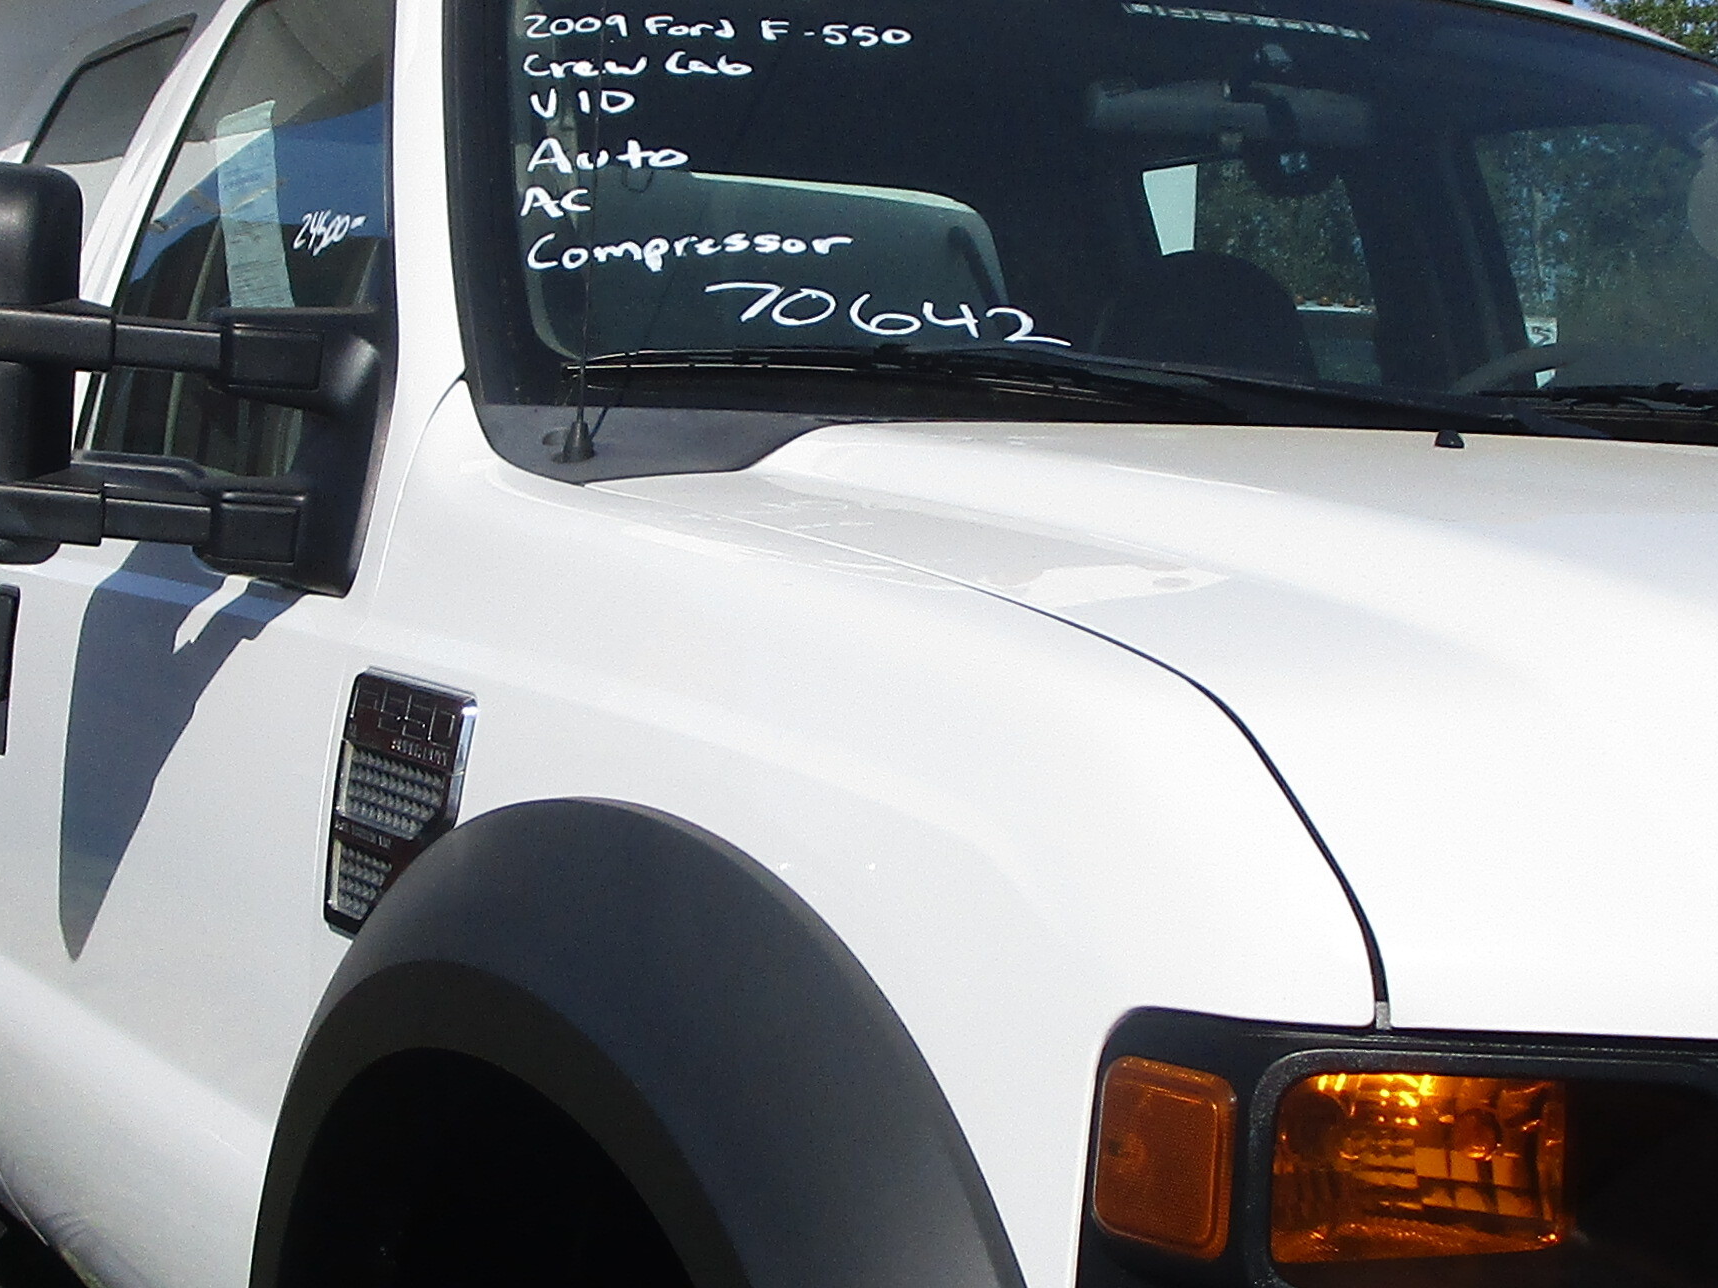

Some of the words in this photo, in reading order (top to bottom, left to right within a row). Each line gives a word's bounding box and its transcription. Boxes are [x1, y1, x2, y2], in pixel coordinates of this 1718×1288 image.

[523, 13, 629, 39] 2009
[644, 15, 735, 39] Ford
[759, 17, 913, 47] F-550
[522, 54, 649, 78] Crew
[664, 50, 753, 76] Cab
[526, 137, 690, 174] Auto
[519, 185, 592, 218] AC
[526, 232, 853, 272] Compressor
[704, 281, 1072, 347] 70642
